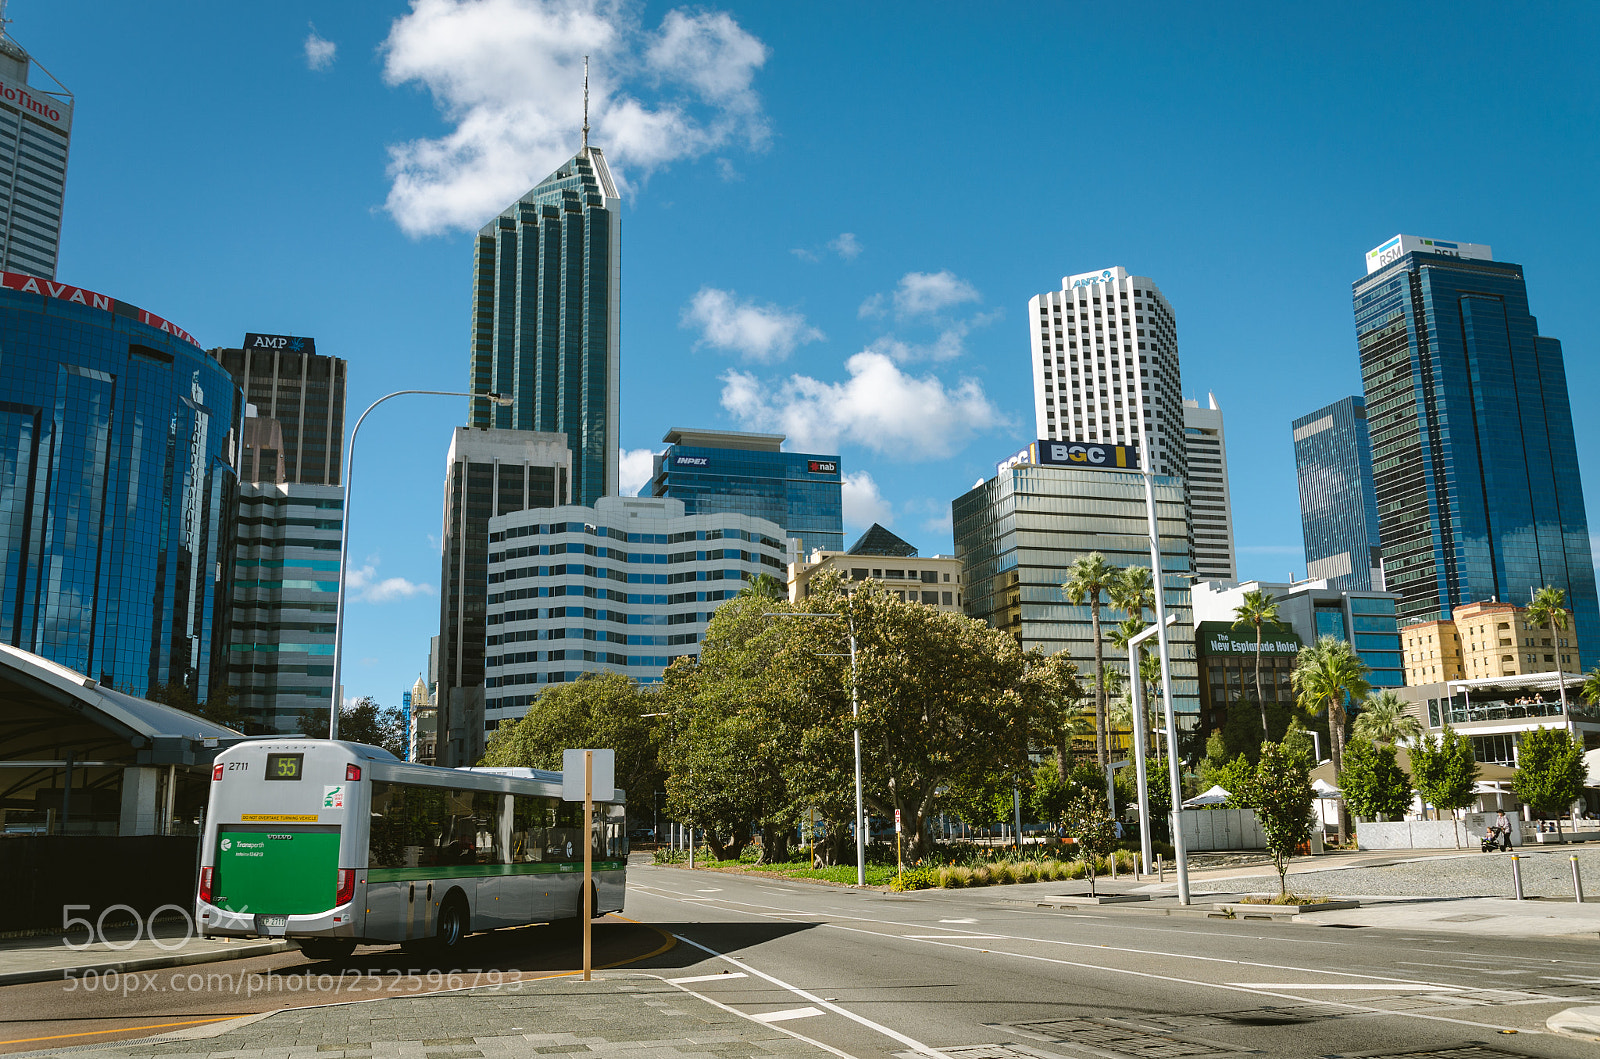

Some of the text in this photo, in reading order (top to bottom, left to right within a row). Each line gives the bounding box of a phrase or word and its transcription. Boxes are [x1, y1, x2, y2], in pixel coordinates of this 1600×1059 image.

[1380, 246, 1401, 266] RSM
[0, 272, 109, 311] LAVAN
[253, 336, 287, 349] AMP
[1051, 444, 1105, 463] BGC
[677, 457, 707, 466] INPEX
[819, 463, 835, 471] nab
[1211, 641, 1299, 653] New Esplanade Hotel
[228, 762, 249, 771] 2711
[278, 758, 296, 776] 55
[236, 841, 265, 849] Transperth
